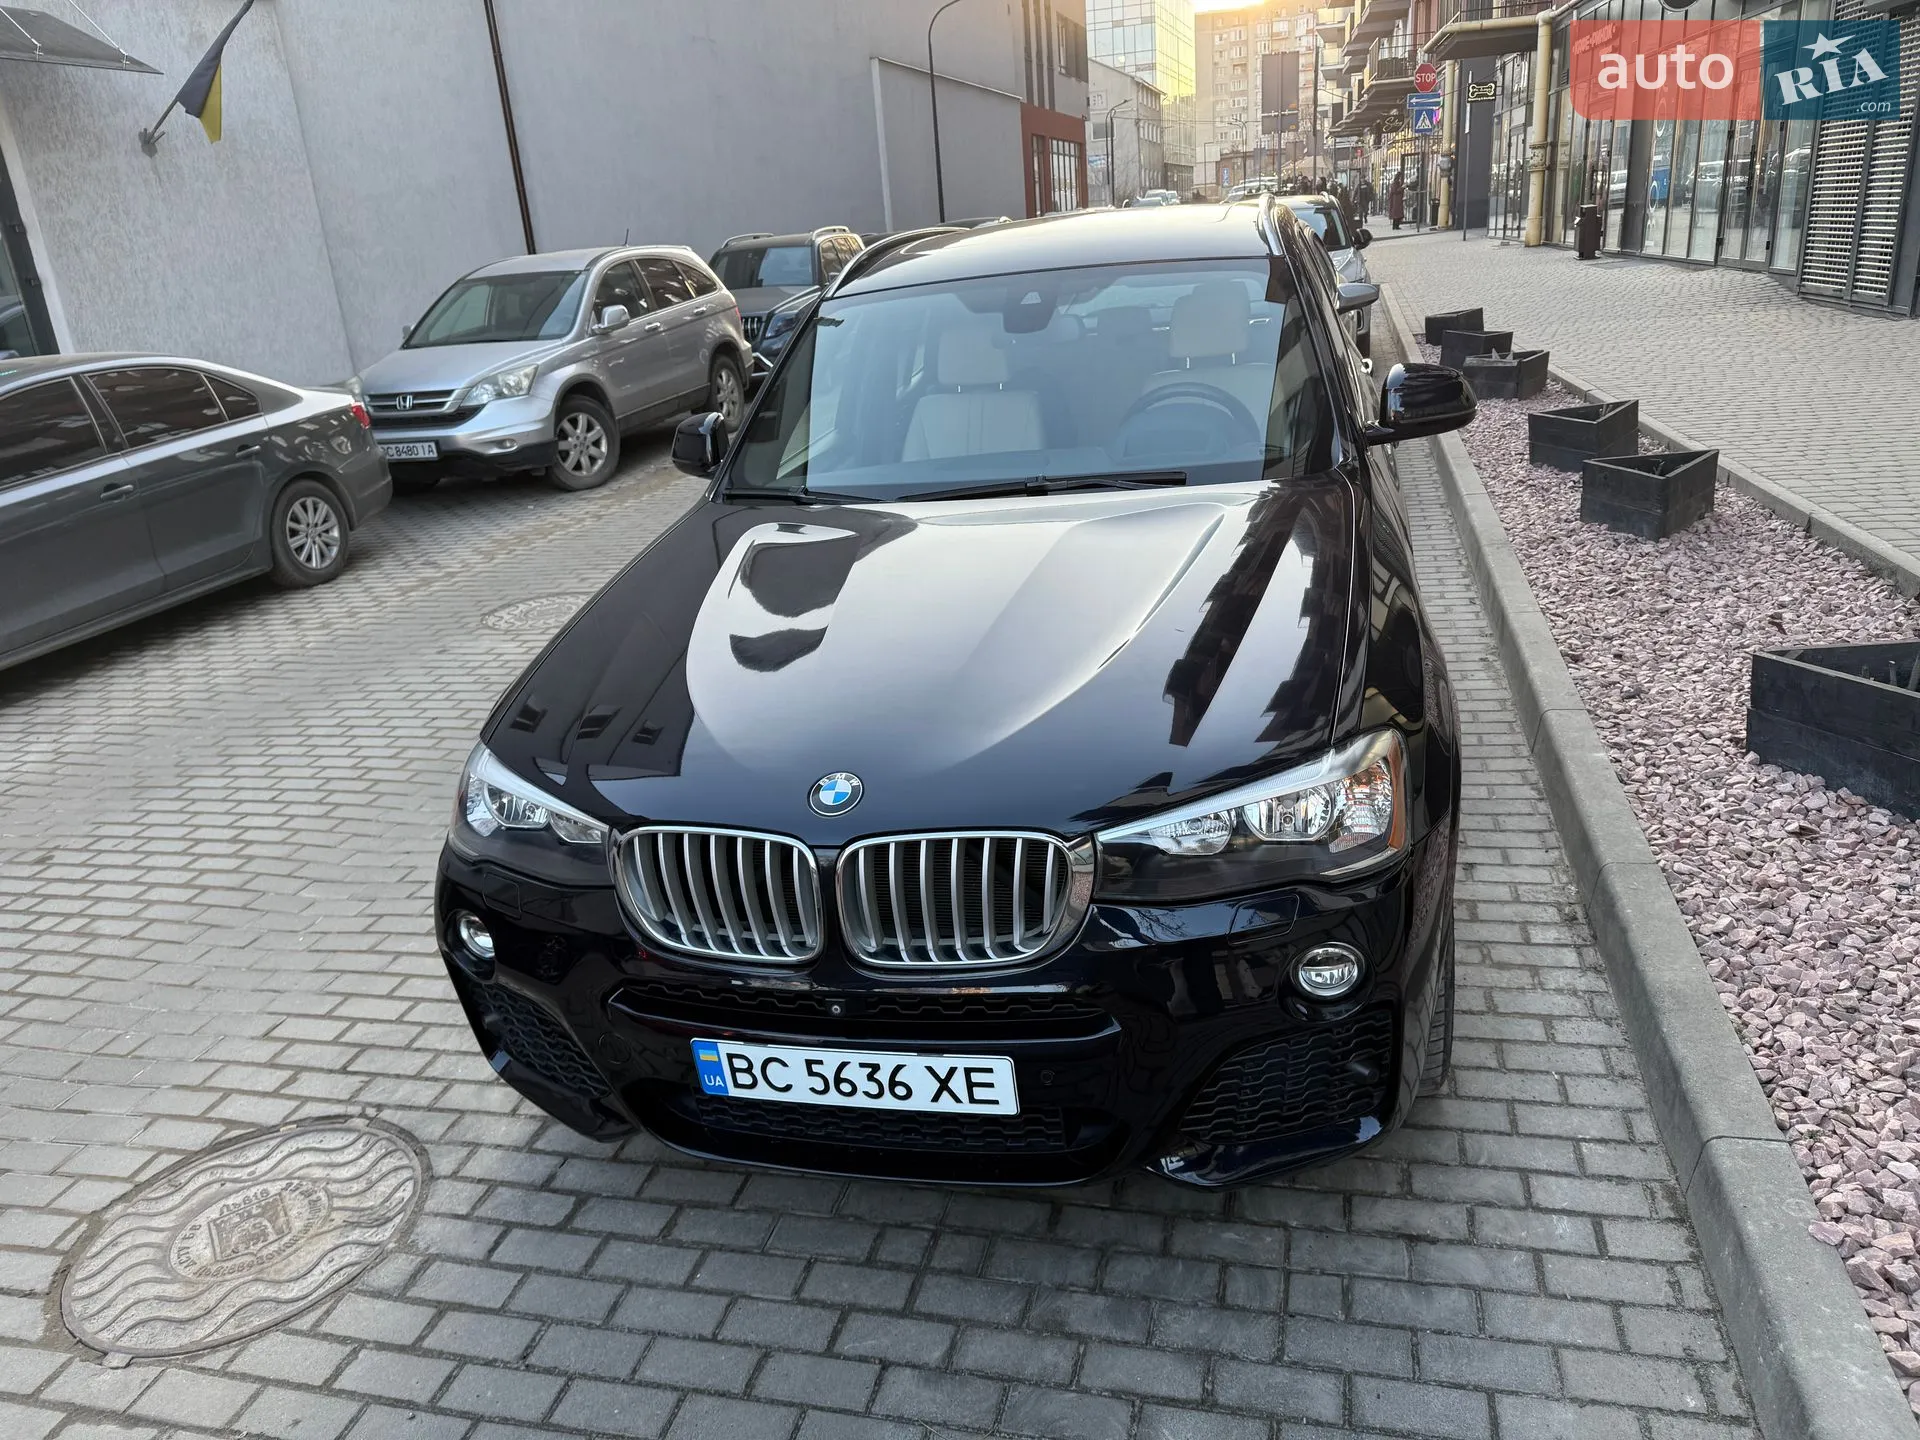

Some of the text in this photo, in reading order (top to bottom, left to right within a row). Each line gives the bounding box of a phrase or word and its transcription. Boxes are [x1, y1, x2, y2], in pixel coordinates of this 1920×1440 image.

[1415, 73, 1436, 83] STOP
[395, 445, 418, 457] 8480
[819, 773, 860, 787] BMW
[705, 1074, 724, 1088] UA
[726, 1052, 1000, 1105] BC 5636 XE
